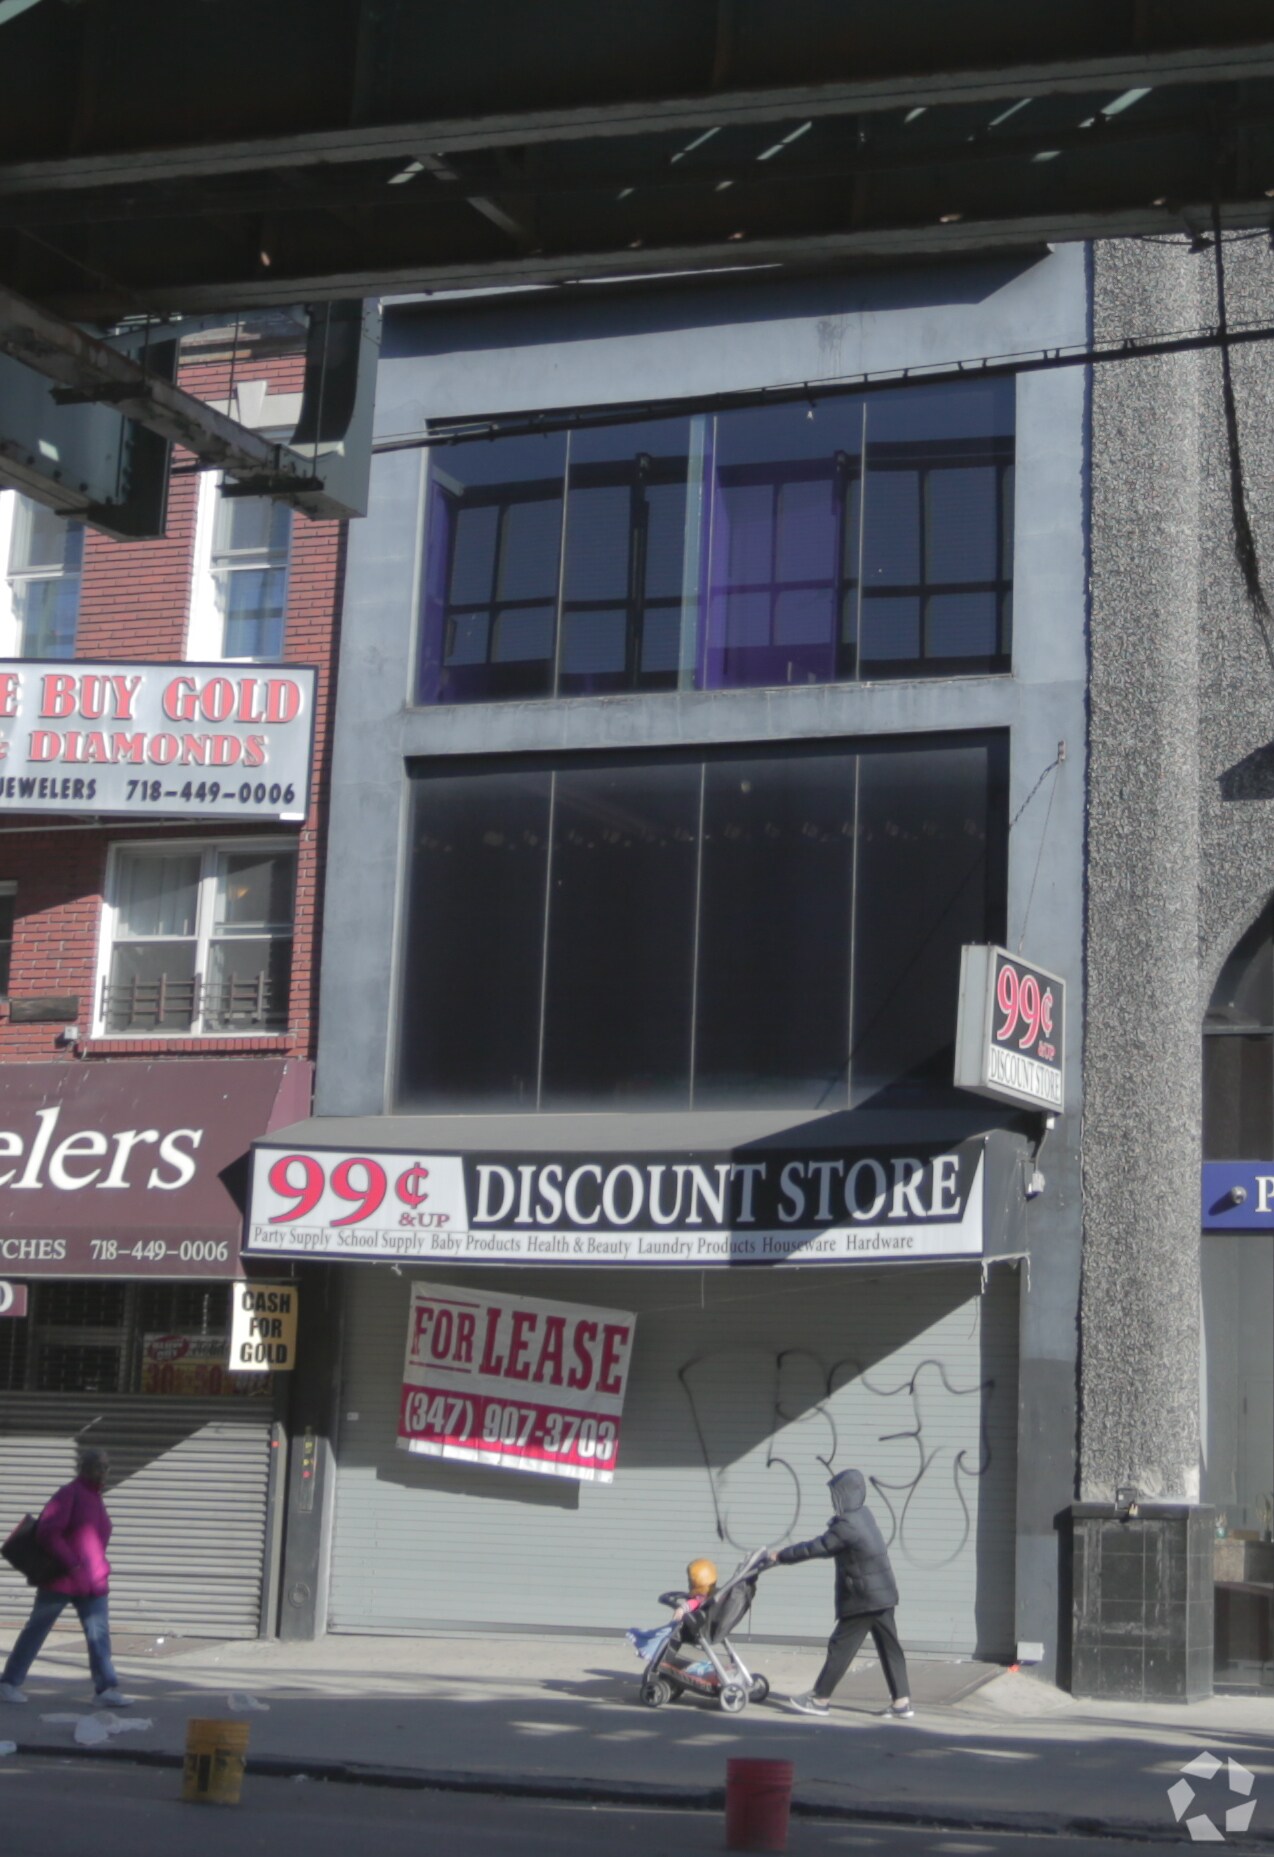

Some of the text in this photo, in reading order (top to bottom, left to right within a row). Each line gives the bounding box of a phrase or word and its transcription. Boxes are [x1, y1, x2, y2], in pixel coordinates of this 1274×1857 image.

[39, 674, 141, 719] BUY
[163, 677, 301, 724] GOLD
[27, 731, 266, 767] DIAMONDS
[126, 779, 296, 805] 718-449-0006
[991, 1047, 1060, 1102] DISCOUNT STORE
[473, 1155, 961, 1225] DISCOUNT STORE
[398, 1212, 450, 1228] &UP
[0, 1239, 228, 1261] CHES 718-449-0006
[254, 1227, 913, 1259] Party Supply School Supply Baby Products Health & Beauty Laundry Products Houseware Hardware
[242, 1291, 291, 1314] CASH
[249, 1317, 282, 1338] FOR
[240, 1342, 288, 1364] GOLD
[410, 1305, 630, 1395] FOR LEASE
[404, 1391, 616, 1461] (347) 907-3703
